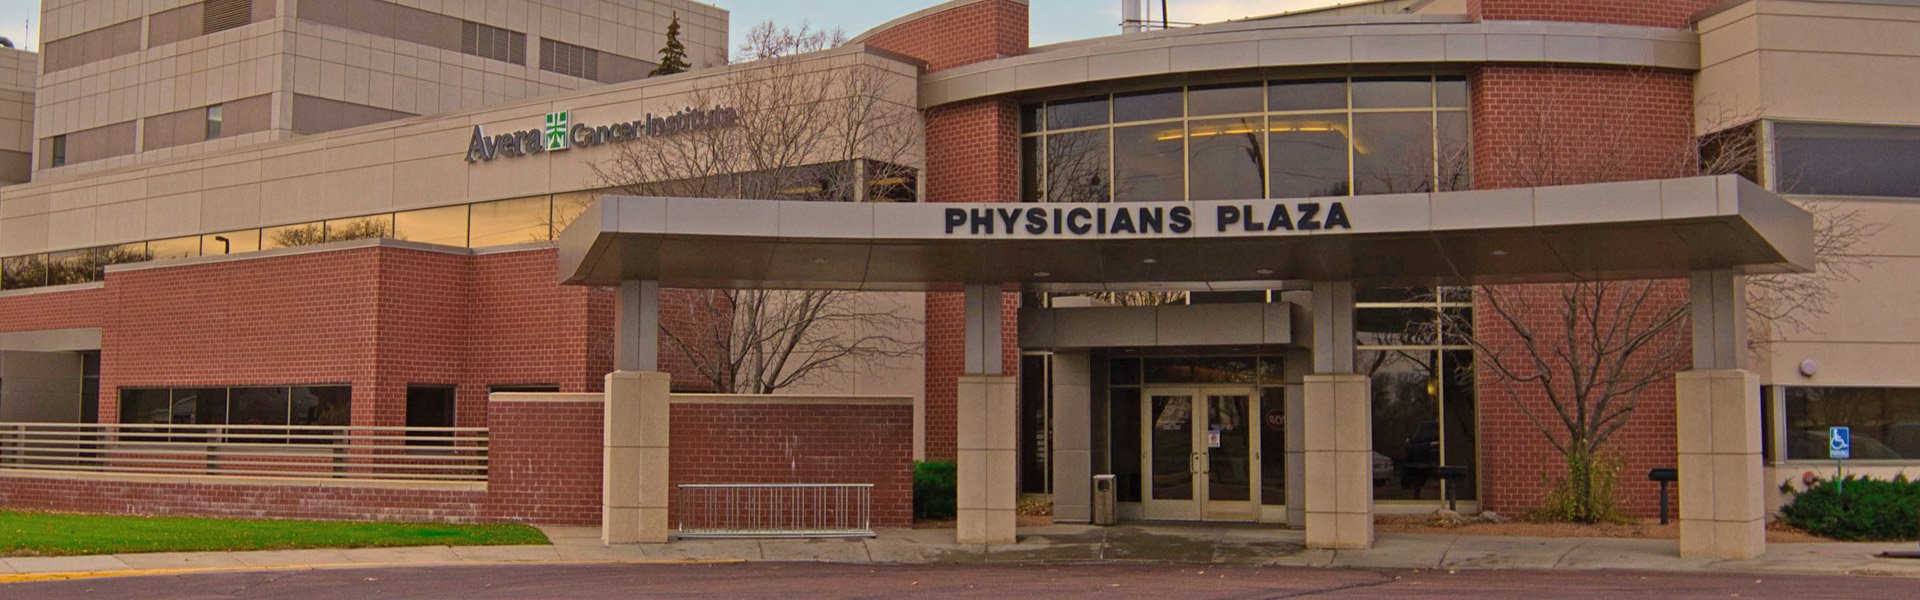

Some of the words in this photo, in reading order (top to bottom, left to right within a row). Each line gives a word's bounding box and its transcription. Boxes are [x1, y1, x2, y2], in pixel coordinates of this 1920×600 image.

[465, 125, 543, 162] Avera
[570, 122, 642, 148] Cancer
[645, 106, 738, 137] Institute
[944, 206, 1193, 235] PHYSICIANS
[1217, 202, 1352, 232] PLAZA
